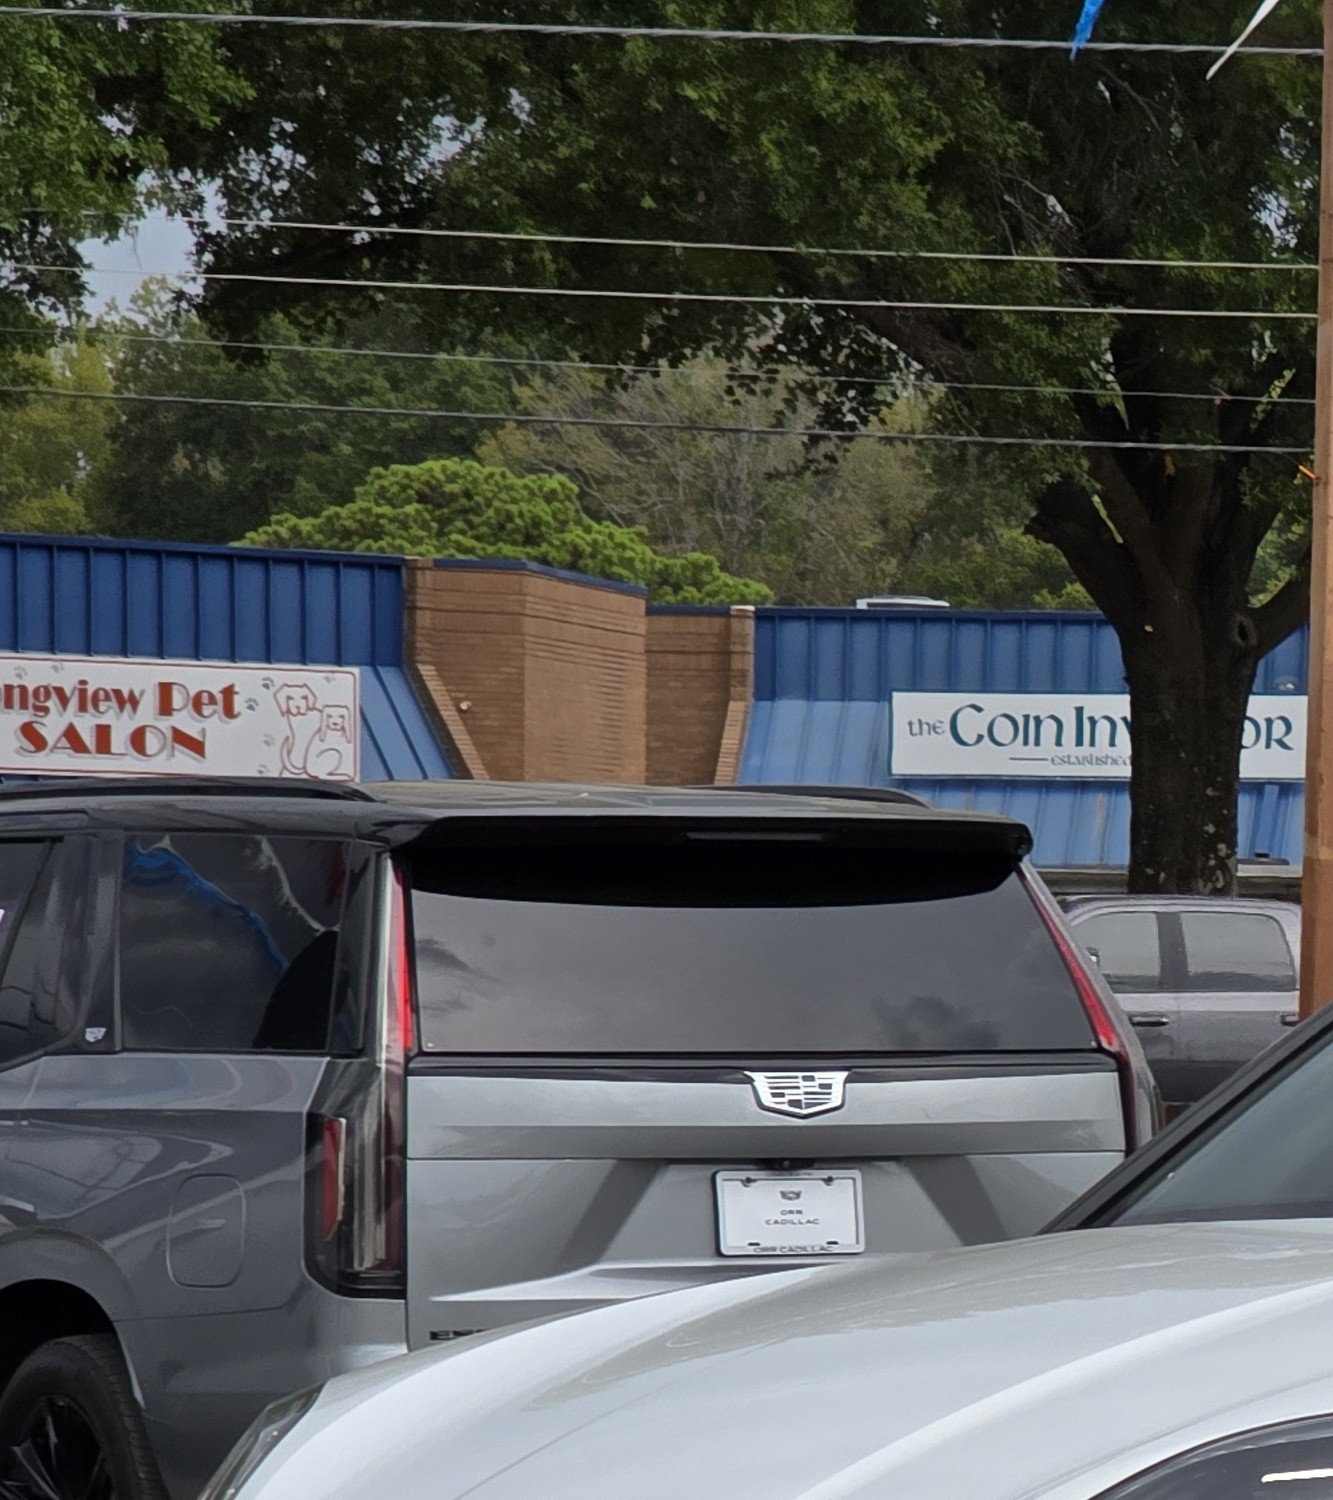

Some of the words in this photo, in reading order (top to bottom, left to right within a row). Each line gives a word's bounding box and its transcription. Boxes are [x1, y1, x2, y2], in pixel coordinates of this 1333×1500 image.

[0, 679, 146, 719] ngview
[157, 681, 242, 720] Pet
[17, 720, 208, 760] SALON
[907, 718, 945, 737] the
[765, 1218, 820, 1226] CADILLAC
